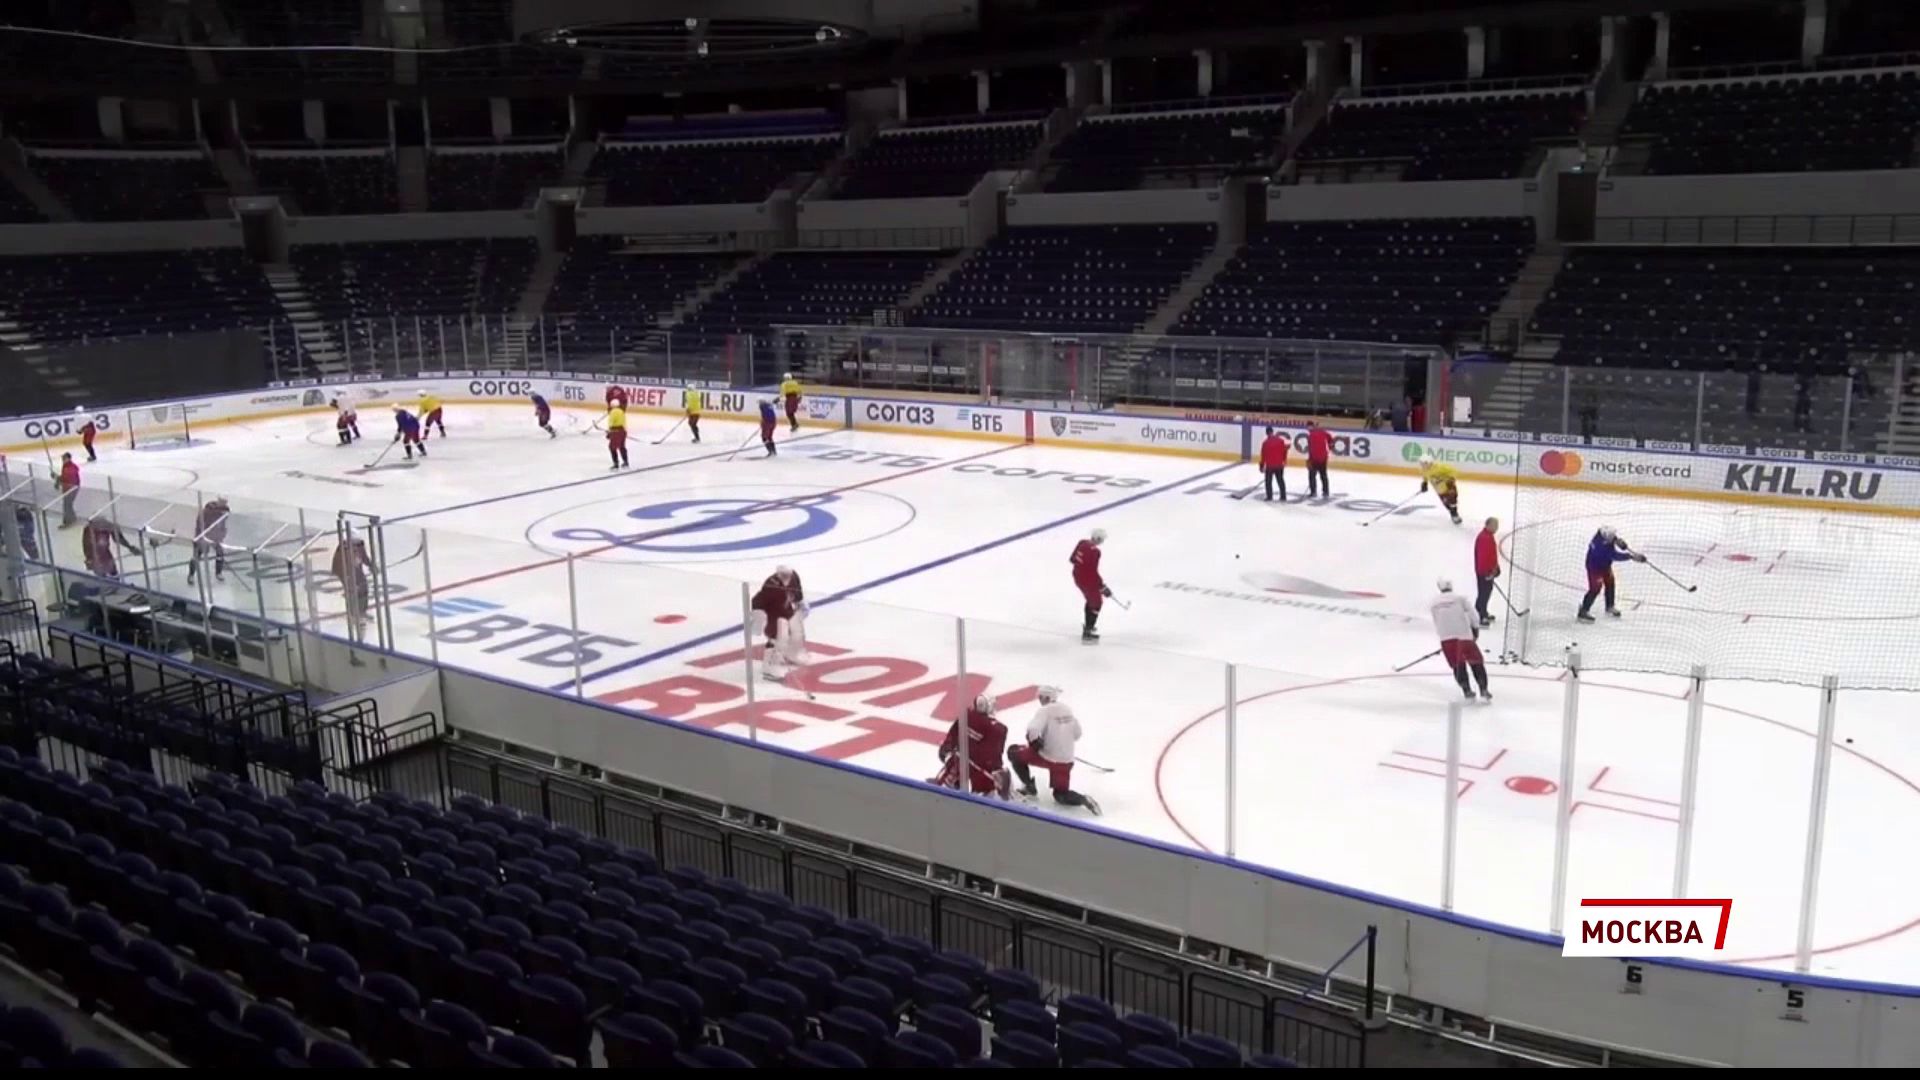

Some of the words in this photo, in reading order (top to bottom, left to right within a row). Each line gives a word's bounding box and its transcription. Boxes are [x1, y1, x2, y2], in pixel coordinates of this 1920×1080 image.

[564, 386, 586, 401] ВТБ
[616, 386, 667, 407] NBET
[24, 413, 111, 439] согз
[972, 414, 1003, 433] ВТБ
[1141, 423, 1217, 443] dynamo.ru
[808, 449, 944, 468] ВТБ
[1590, 460, 1692, 479] mastercard
[1723, 463, 1883, 500] KHL.RU
[428, 614, 640, 668] ВТБ
[1626, 965, 1643, 984] 6
[1786, 989, 1805, 1009] 5
